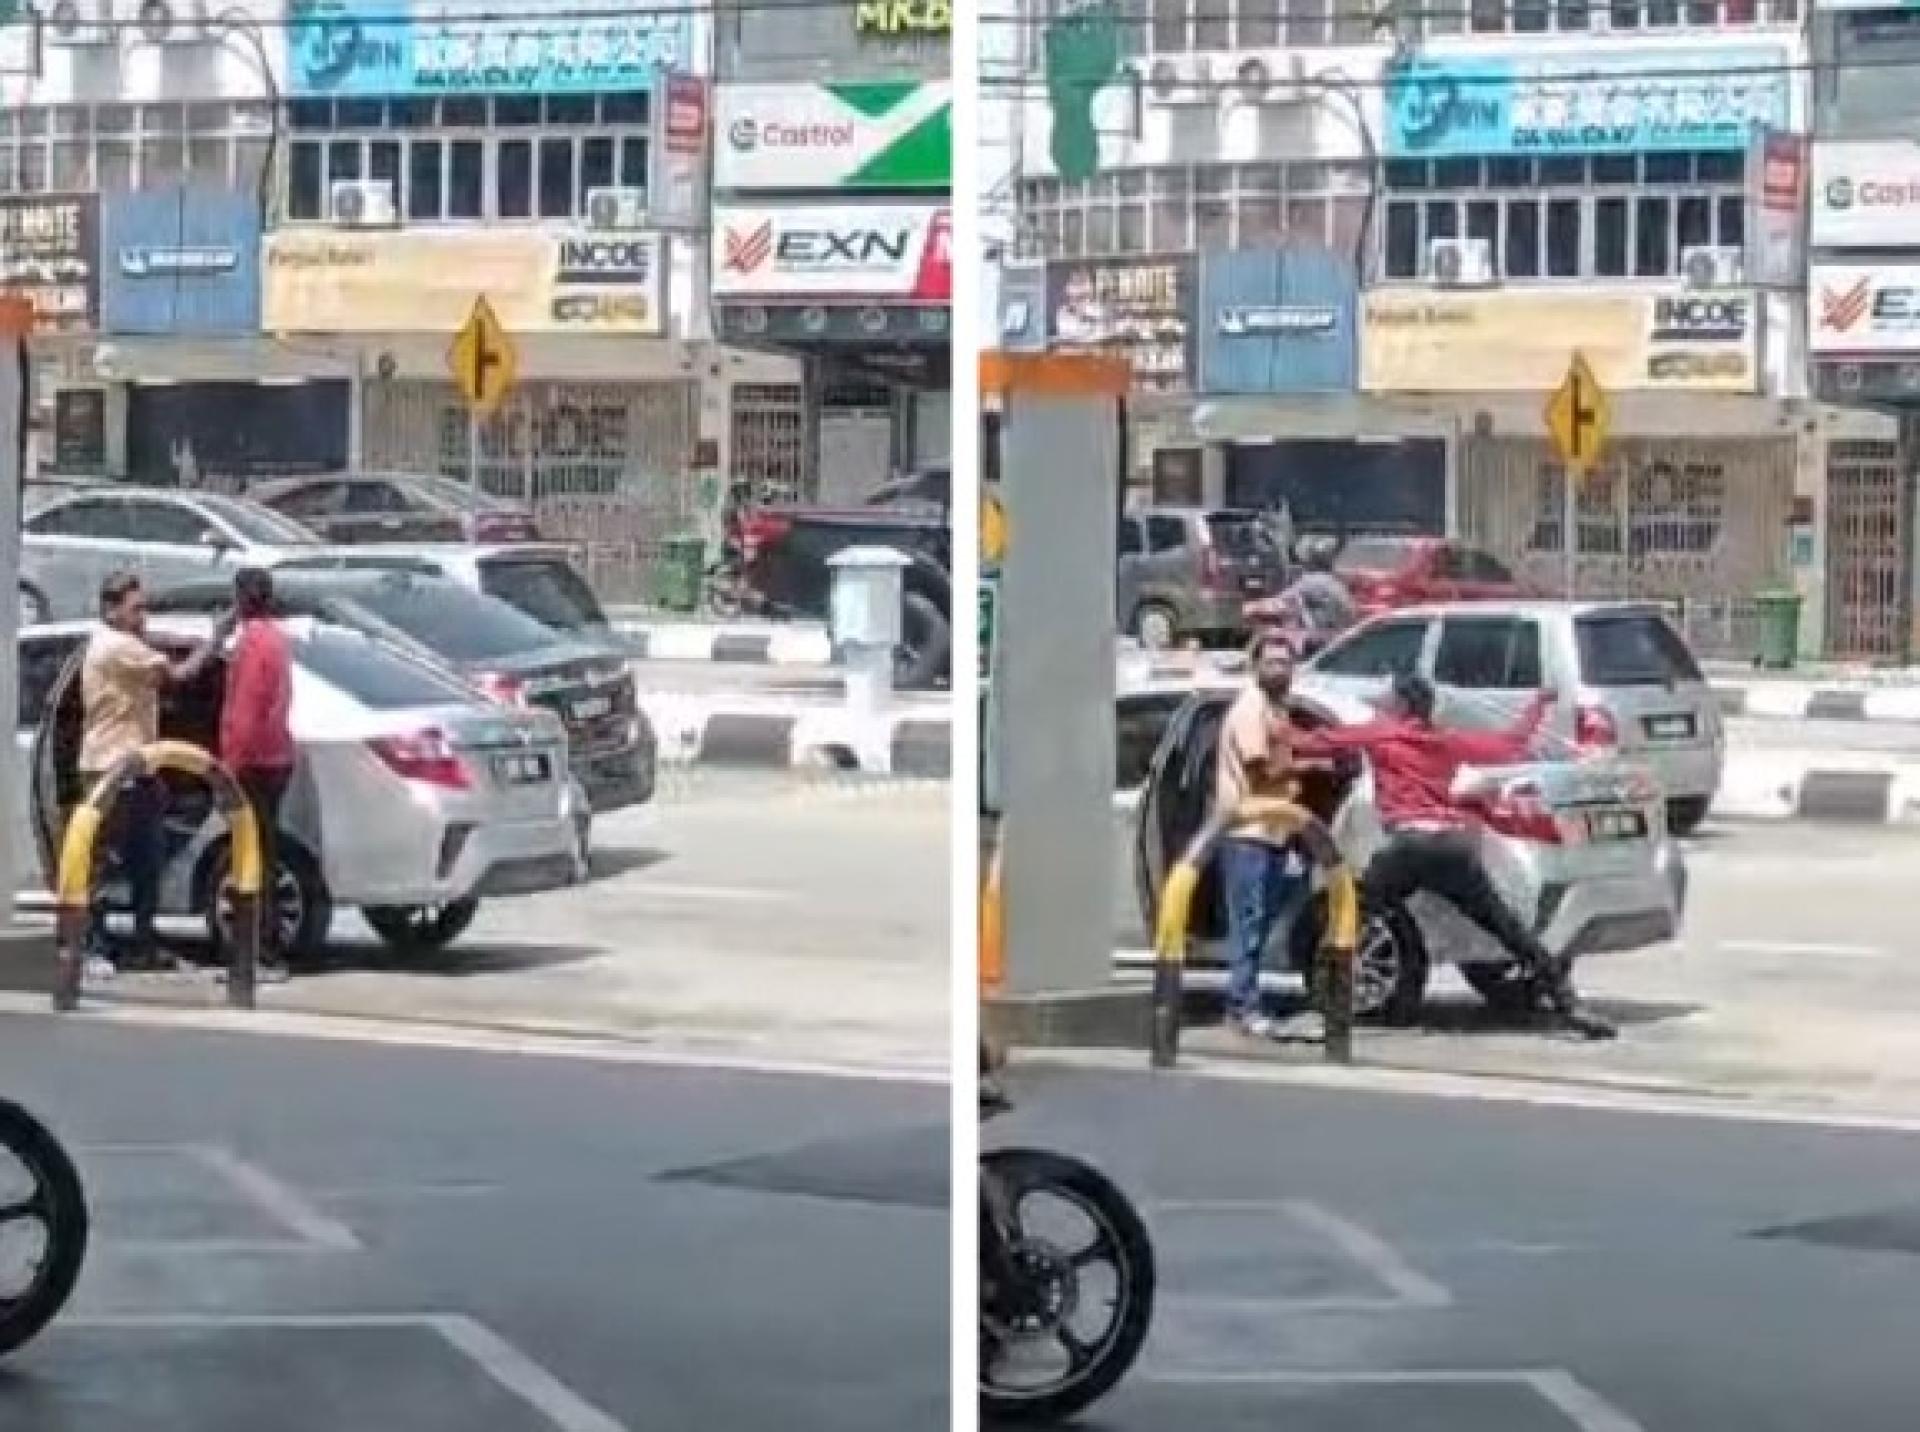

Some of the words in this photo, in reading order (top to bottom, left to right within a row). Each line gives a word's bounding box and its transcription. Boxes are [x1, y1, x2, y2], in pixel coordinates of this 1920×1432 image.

[763, 121, 855, 147] Castrol
[559, 240, 649, 268] INCOE
[775, 230, 910, 261] EXN
[1656, 296, 1745, 327] INCOE
